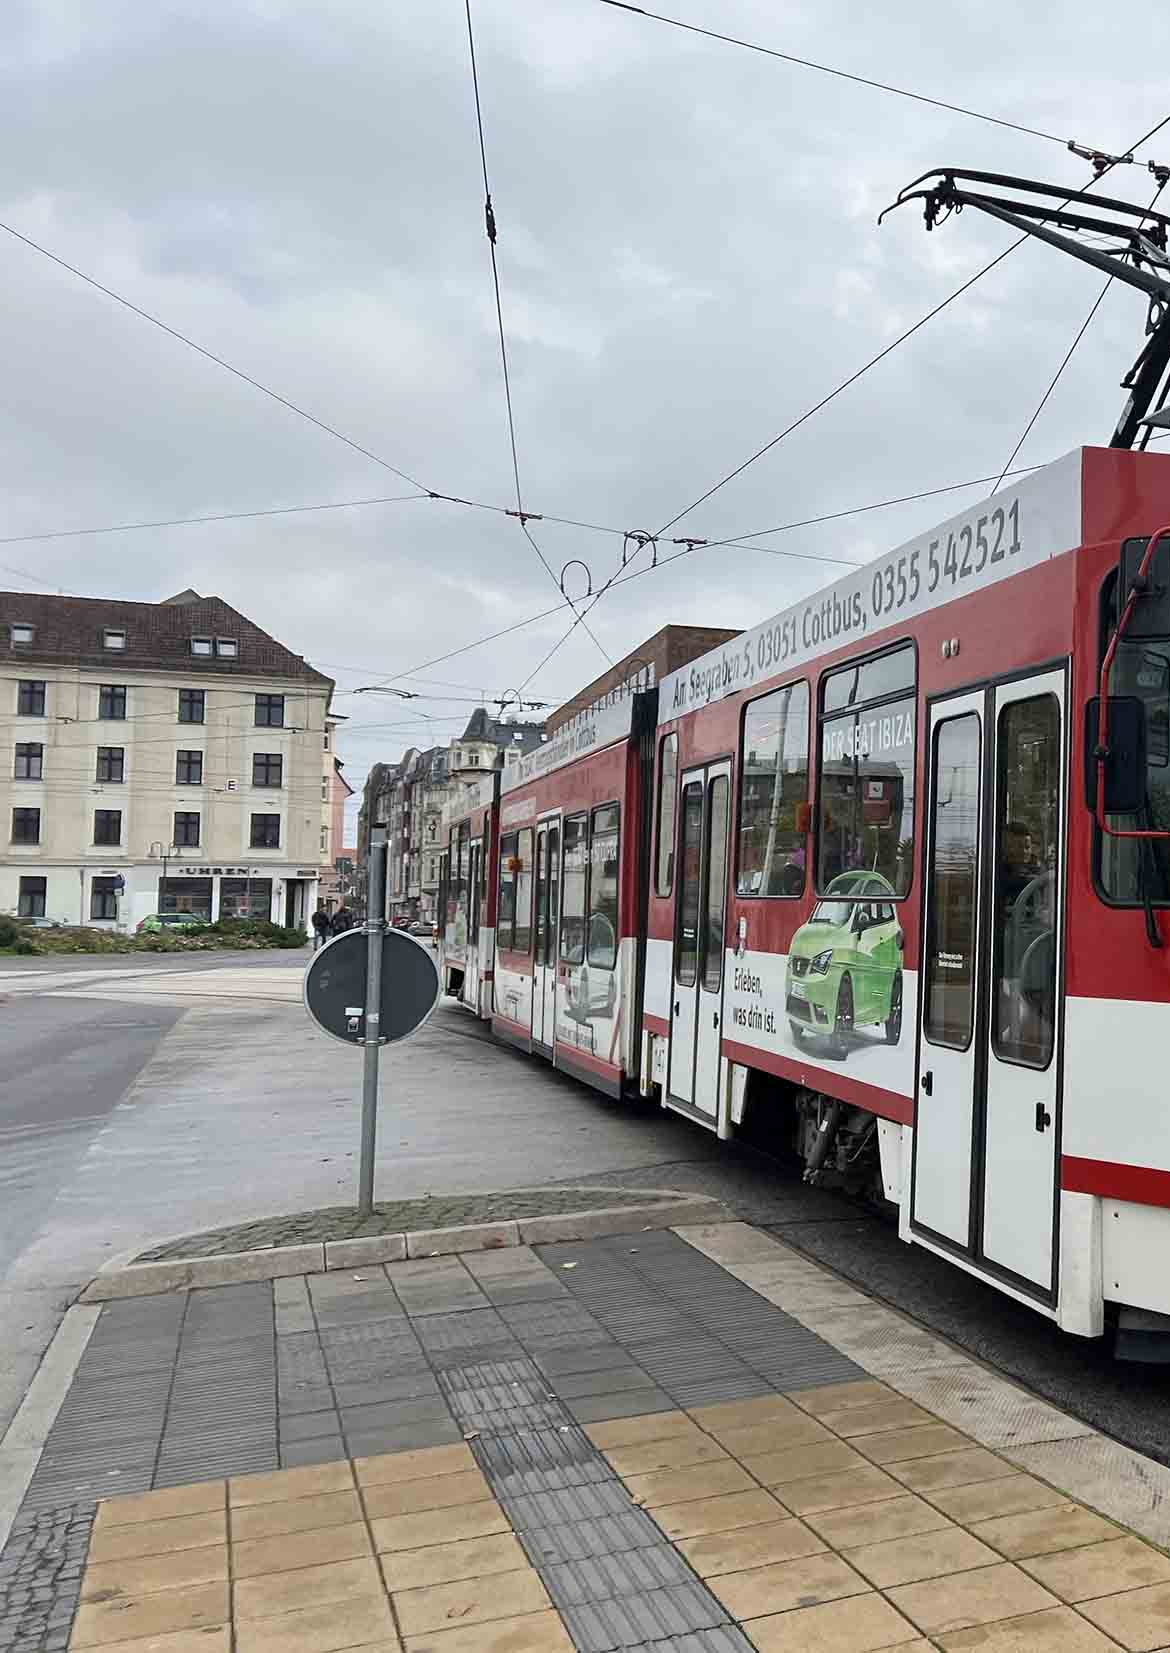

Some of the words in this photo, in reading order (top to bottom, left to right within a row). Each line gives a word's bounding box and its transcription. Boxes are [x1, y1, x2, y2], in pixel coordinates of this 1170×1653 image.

[689, 649, 740, 702] Seegraben
[758, 617, 798, 669] 03051
[802, 591, 868, 649] Cottbus,
[872, 550, 920, 617] 0355
[928, 497, 1022, 593] 542521
[879, 711, 913, 751] IBIZA
[185, 867, 248, 876] UHREN
[734, 967, 763, 998] Erleben,
[733, 1006, 747, 1027] was
[747, 1004, 763, 1031] drin
[763, 1007, 777, 1034] ist.
